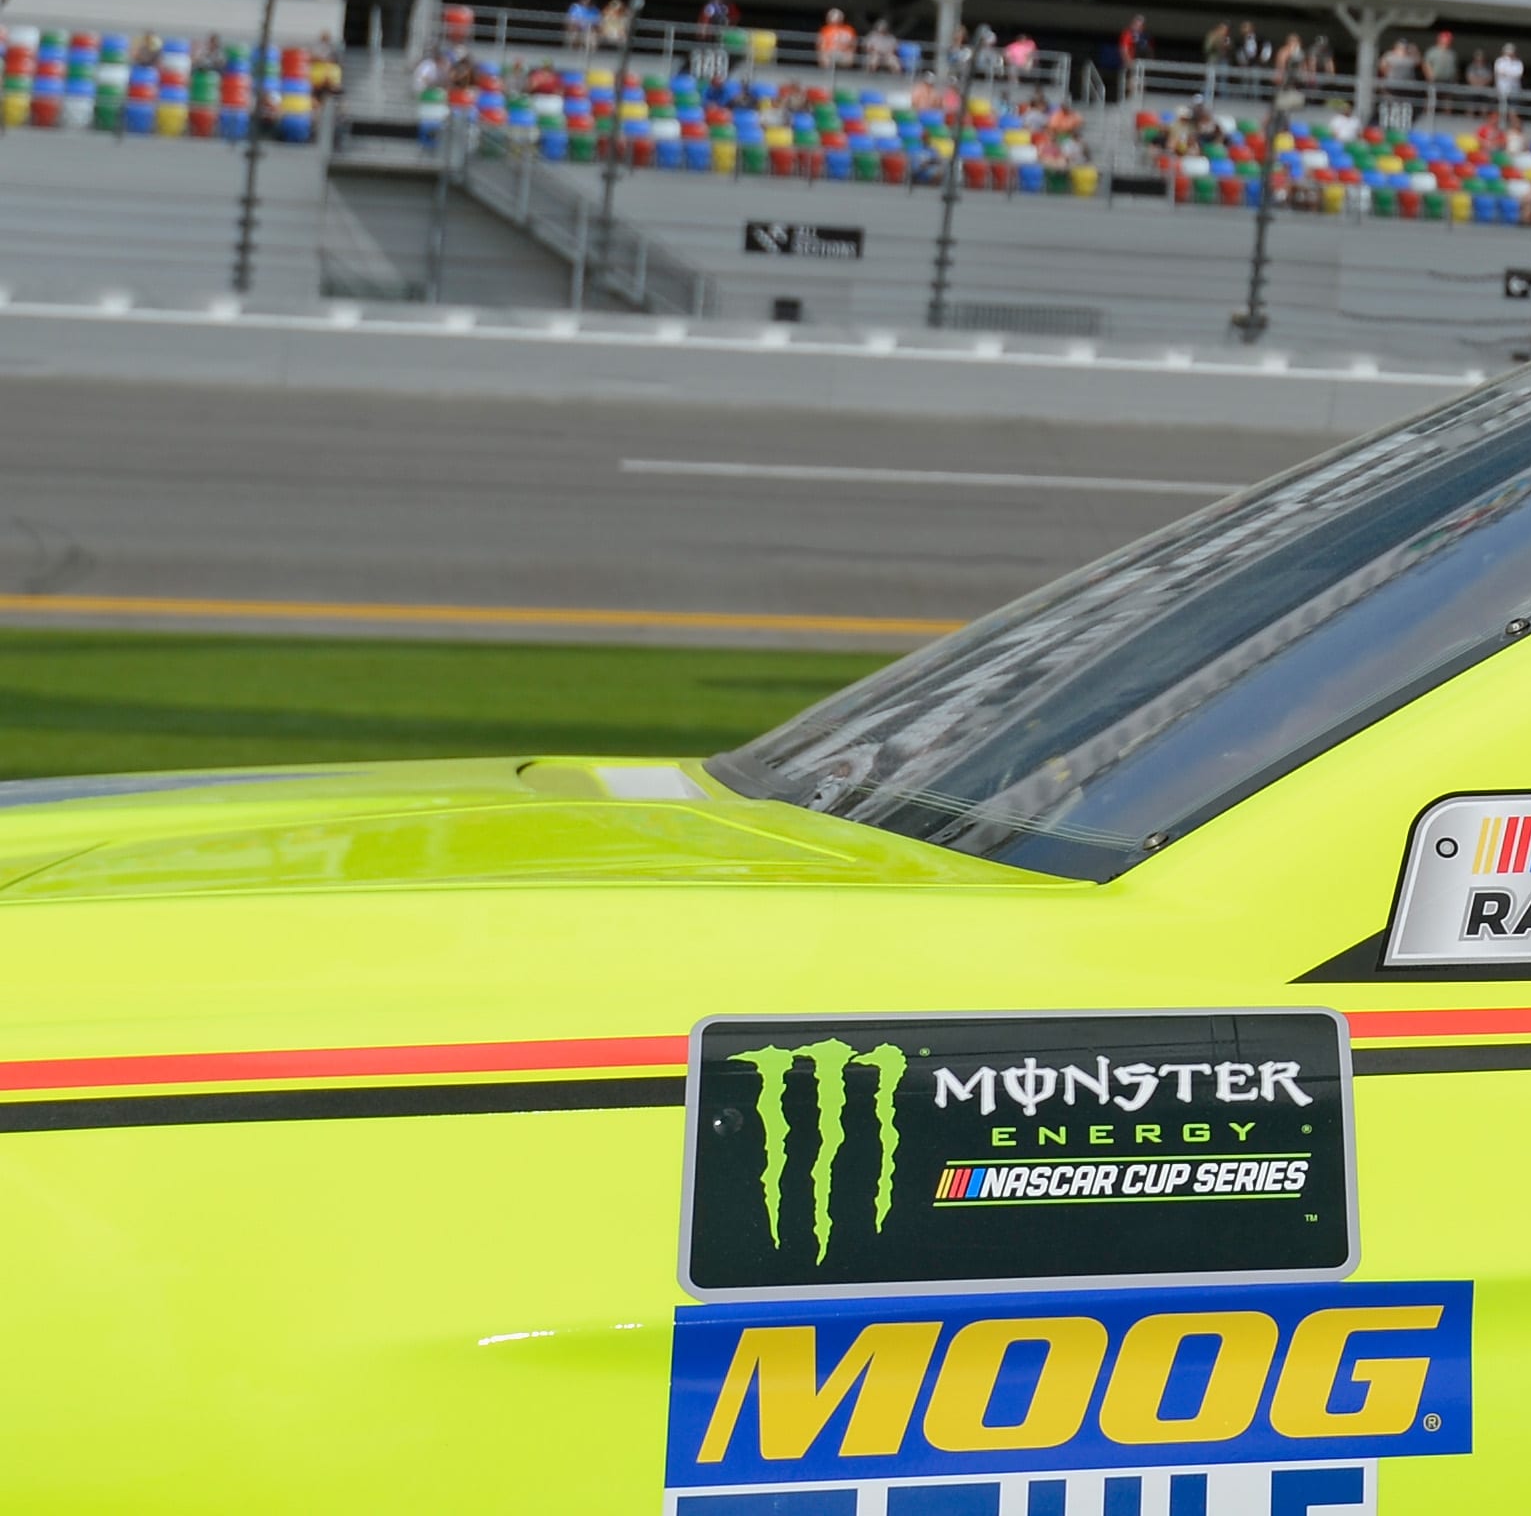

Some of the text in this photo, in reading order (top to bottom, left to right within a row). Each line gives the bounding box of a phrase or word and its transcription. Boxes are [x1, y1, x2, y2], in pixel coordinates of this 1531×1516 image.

[933, 1055, 1314, 1118] MONSTER
[990, 1121, 1257, 1148] ENERGY
[976, 1160, 1311, 1200] NASCAR CUP SERIES
[696, 1304, 1445, 1464] MOOG
